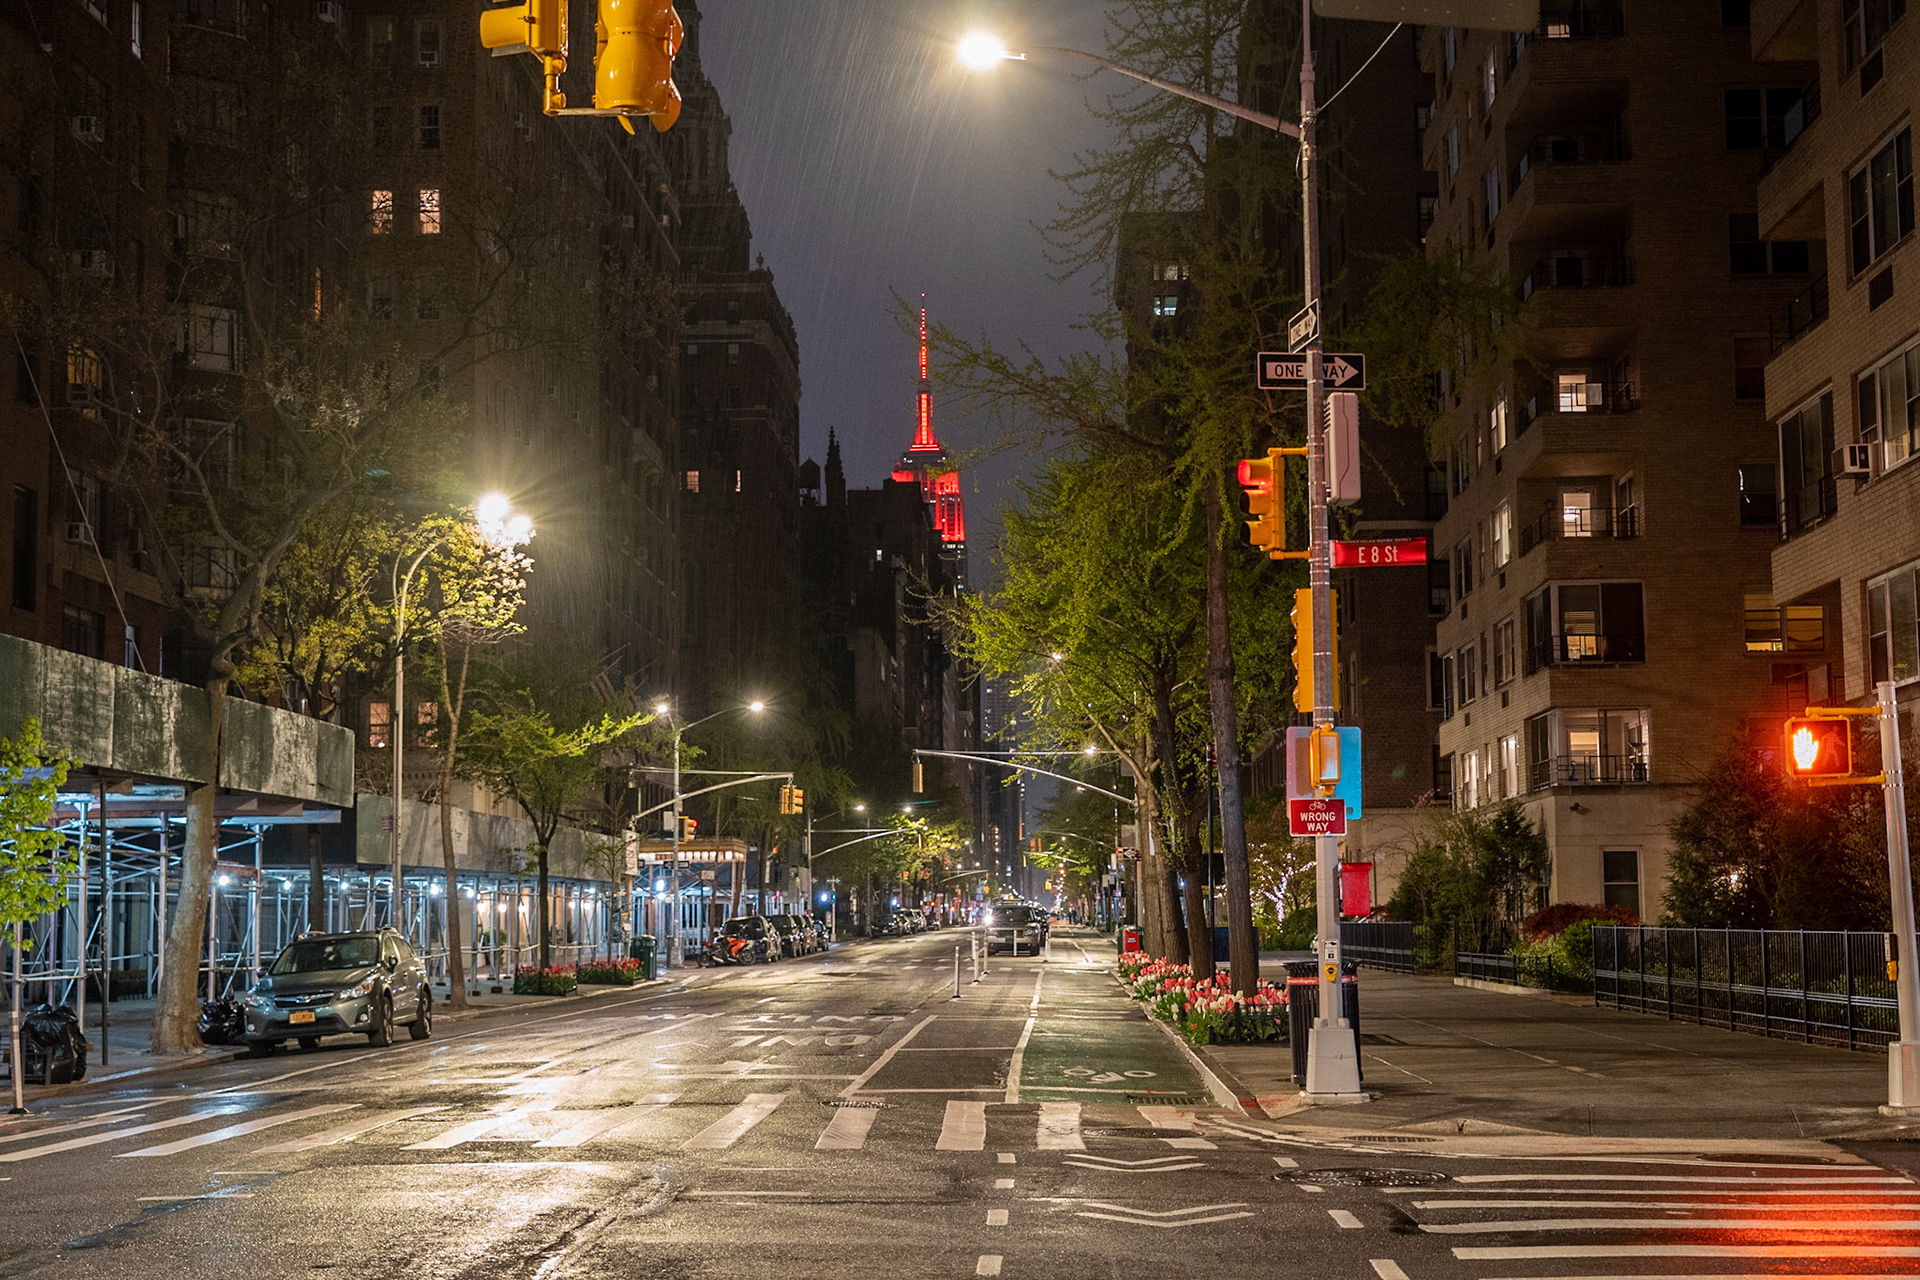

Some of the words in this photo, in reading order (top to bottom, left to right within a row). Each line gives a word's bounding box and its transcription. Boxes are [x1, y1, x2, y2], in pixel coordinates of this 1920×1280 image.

[1274, 364, 1304, 377] ONE
[1358, 546, 1366, 564] E
[1371, 546, 1379, 563] 8
[1384, 545, 1398, 563] St
[1300, 811, 1336, 822] WRONG
[1306, 822, 1329, 832] WAY
